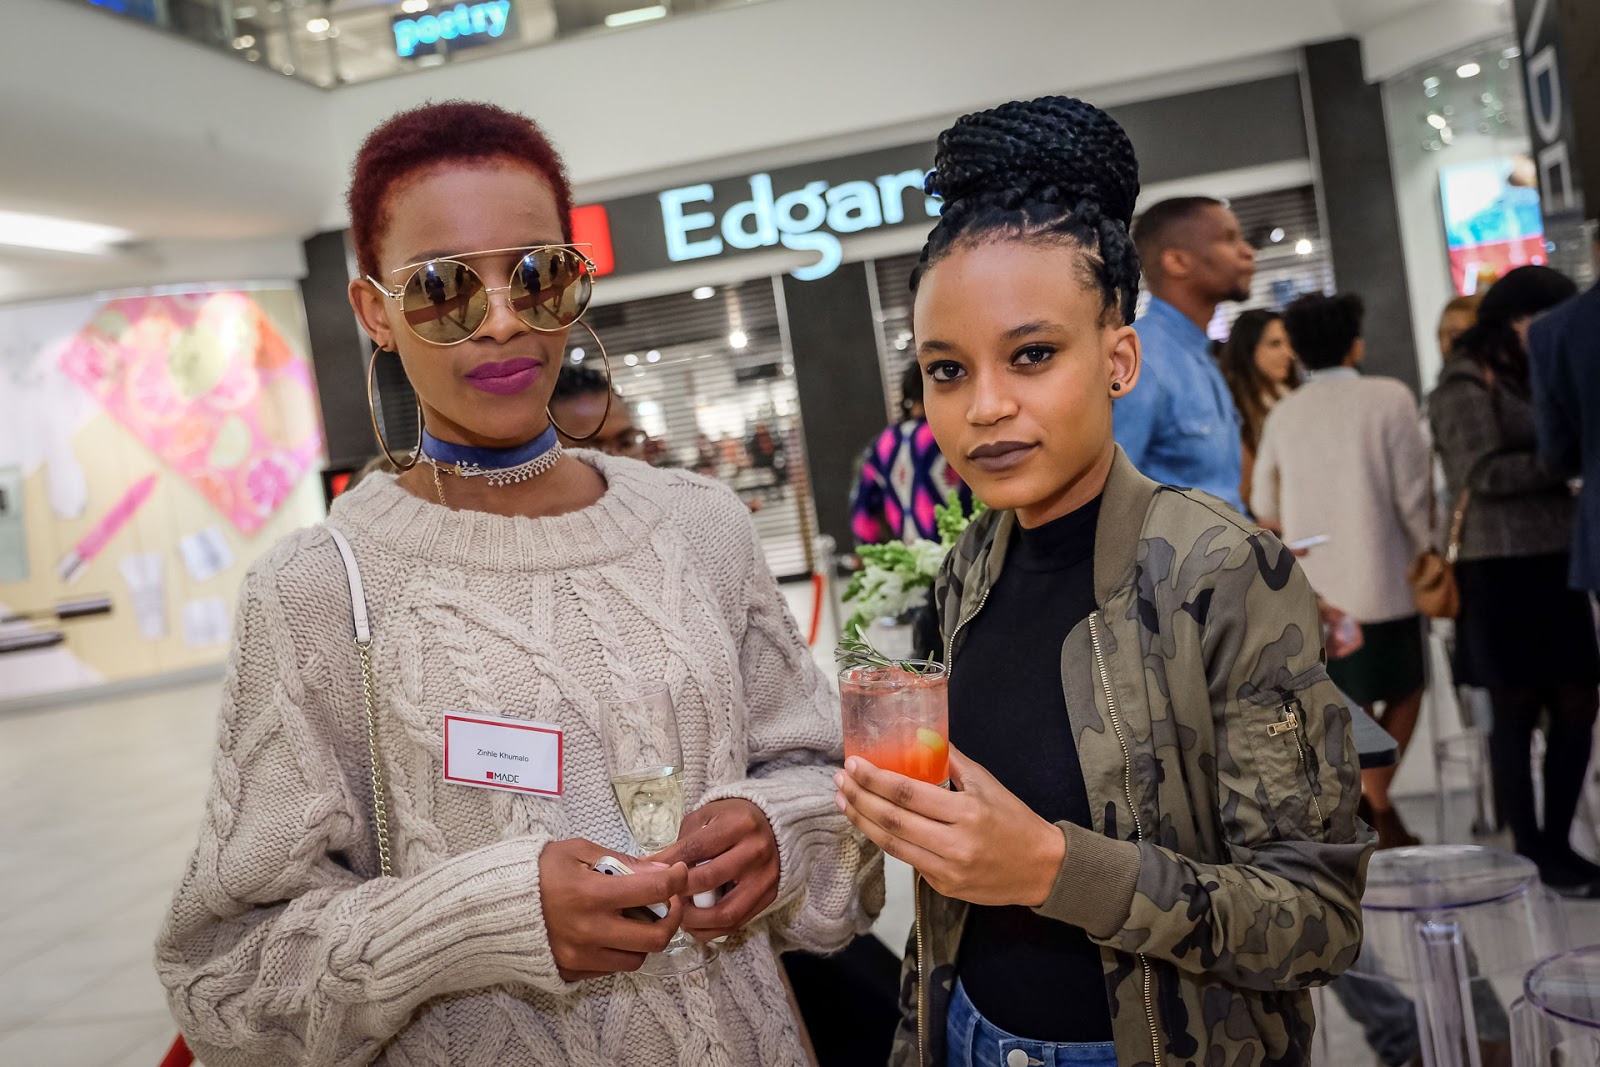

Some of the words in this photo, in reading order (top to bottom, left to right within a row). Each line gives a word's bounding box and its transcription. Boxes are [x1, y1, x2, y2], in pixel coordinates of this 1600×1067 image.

[393, 0, 510, 56] poetry
[476, 748, 498, 758] Zinhle
[499, 752, 529, 762] Khumalo
[494, 772, 519, 783] MADE
